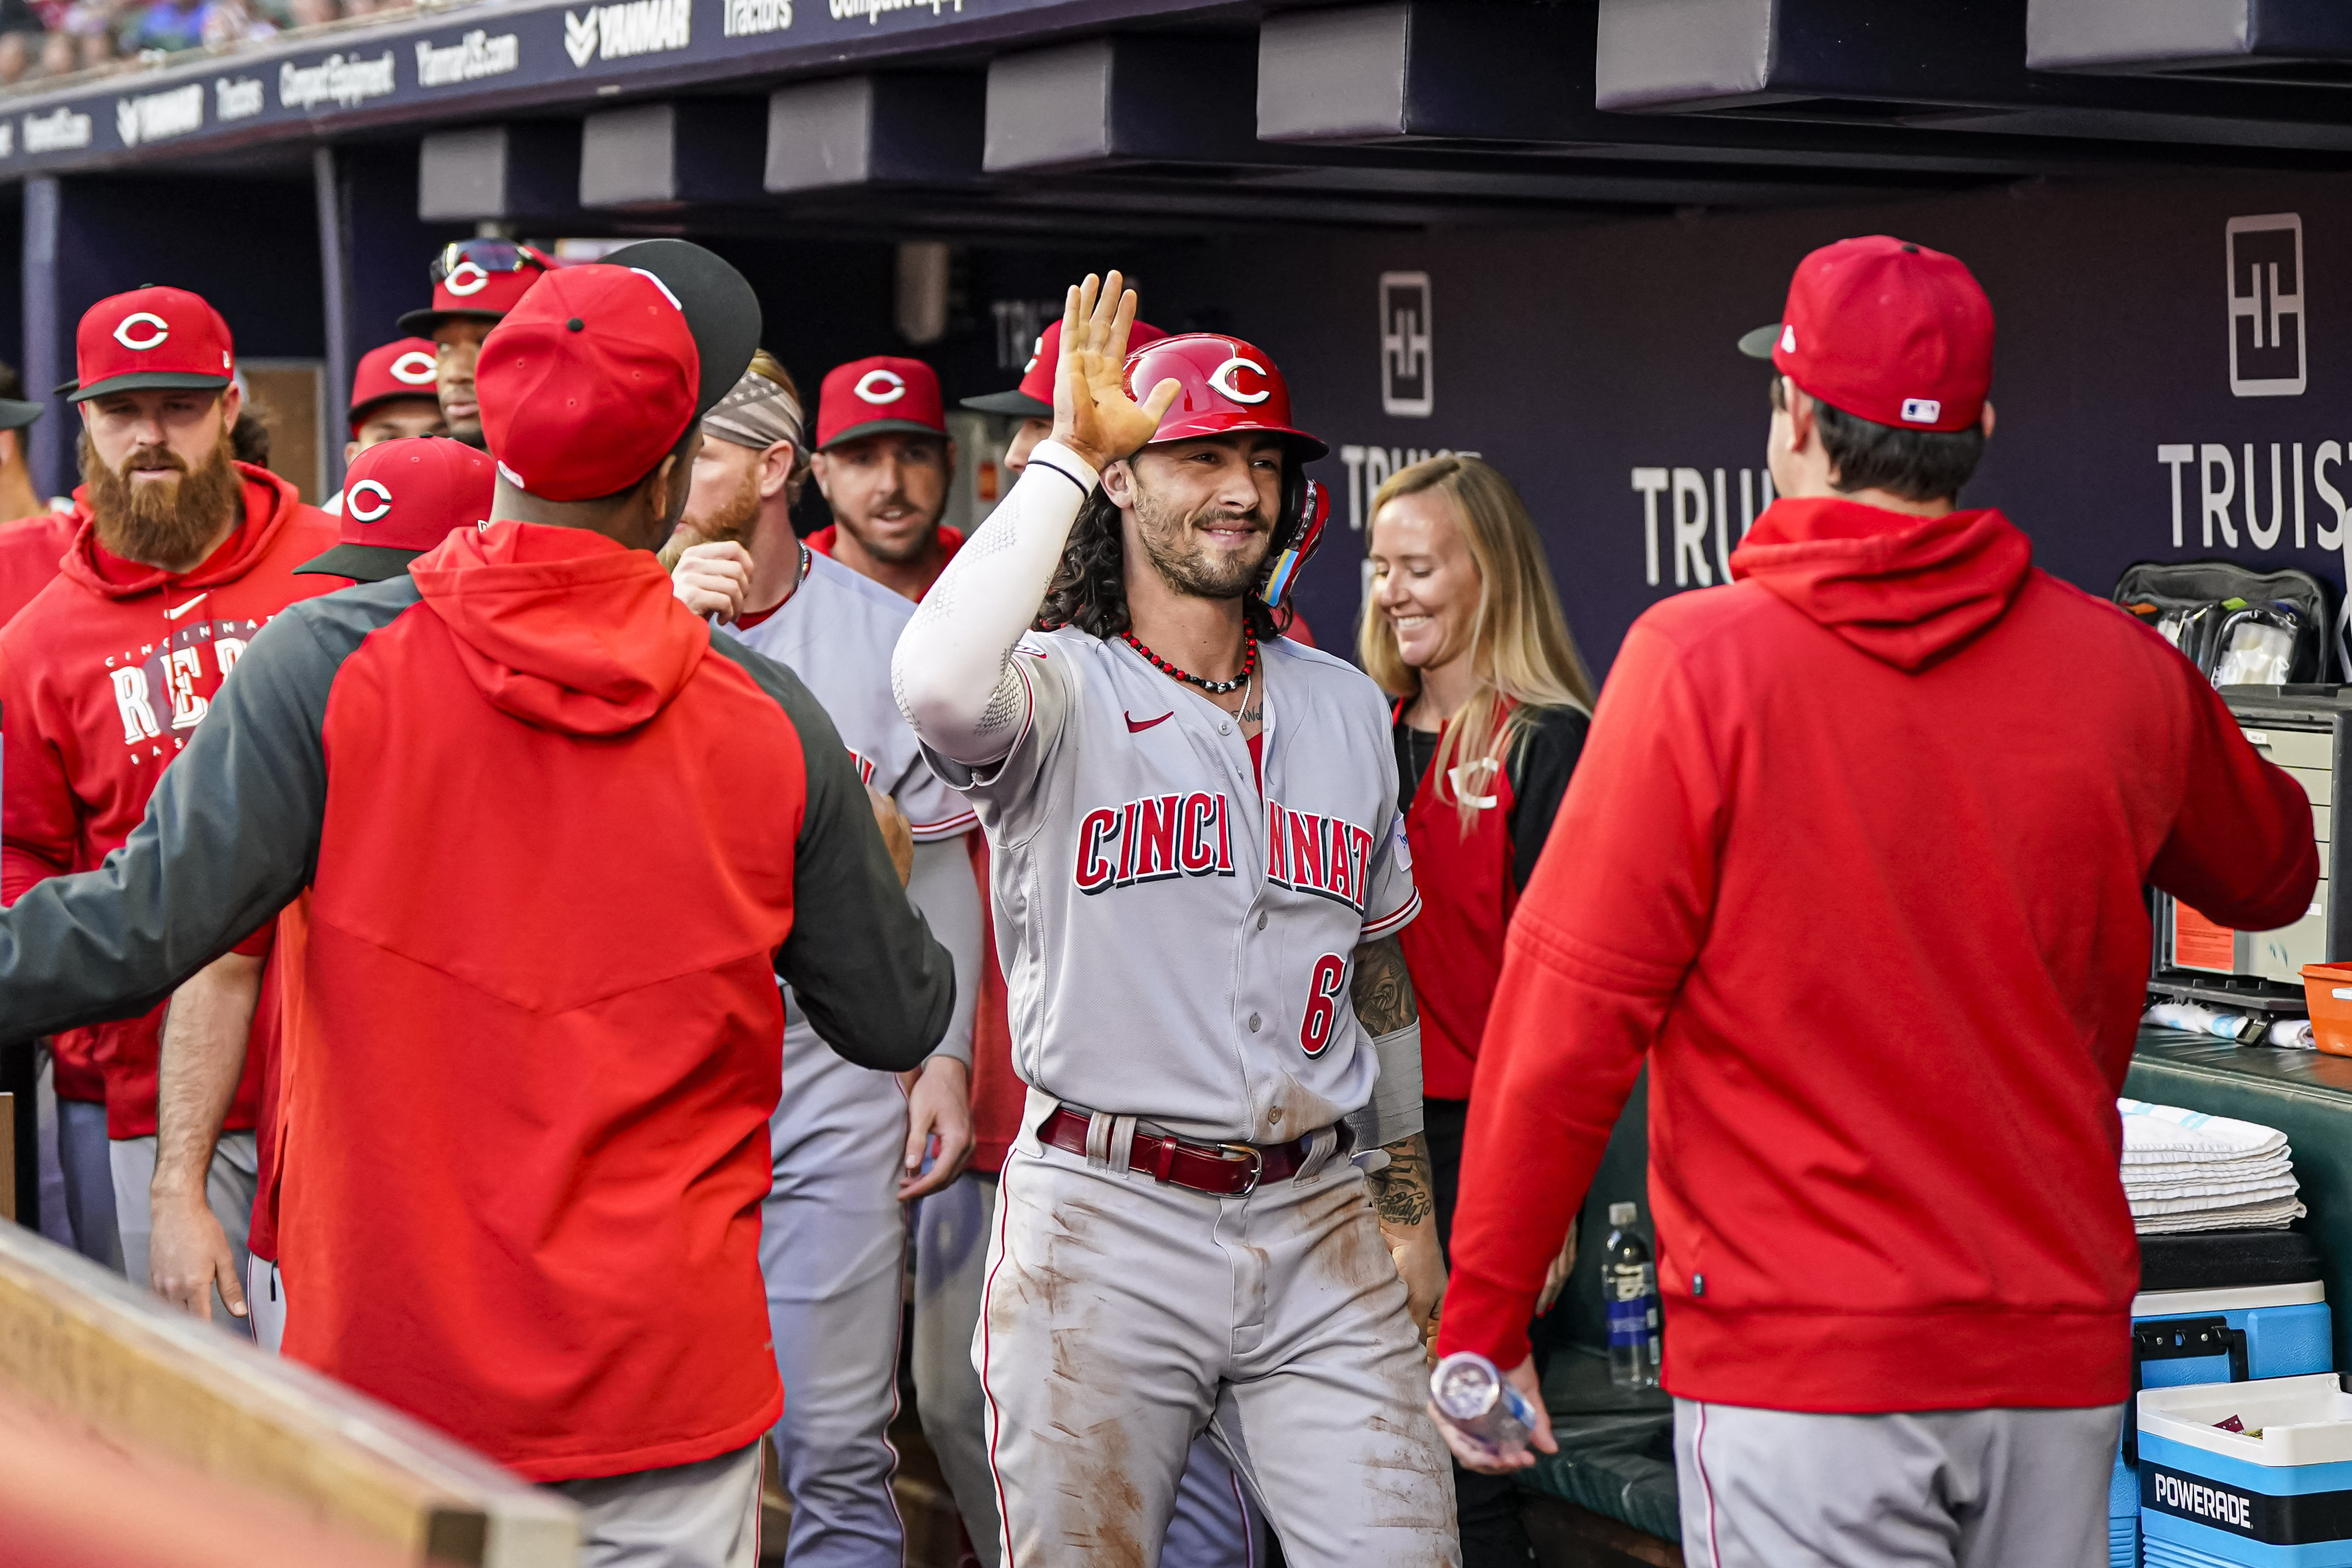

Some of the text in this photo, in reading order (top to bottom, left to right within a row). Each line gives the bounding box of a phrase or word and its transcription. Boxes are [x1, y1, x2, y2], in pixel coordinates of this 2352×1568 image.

[598, 0, 692, 61] YANMAR
[113, 312, 169, 351] C
[854, 369, 907, 404] C
[1206, 357, 1271, 404] C
[346, 479, 392, 523] C
[2157, 440, 2352, 550] TRUIS
[1299, 951, 1347, 1060] 6
[2155, 1473, 2251, 1529] POWERADE
